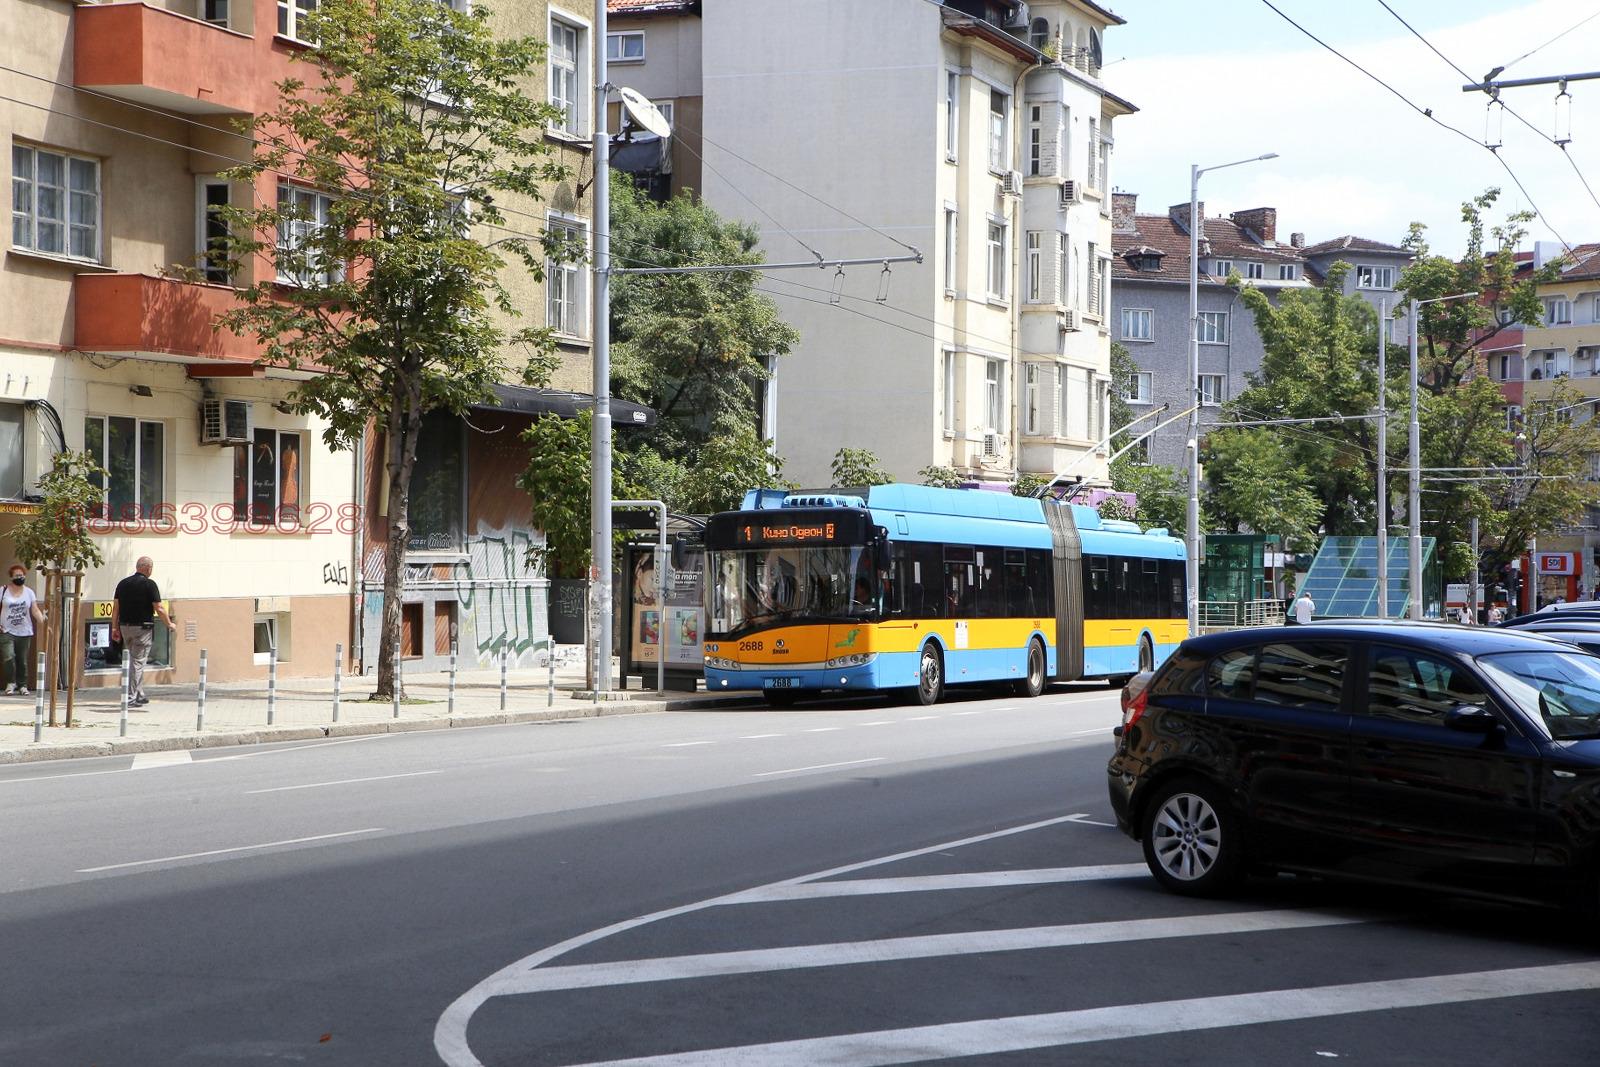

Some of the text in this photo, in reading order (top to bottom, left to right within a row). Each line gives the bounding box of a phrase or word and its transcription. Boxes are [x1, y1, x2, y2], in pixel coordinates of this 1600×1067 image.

[744, 526, 823, 541] 1 Кино Одеон
[717, 620, 722, 633] 1
[740, 641, 764, 652] 2688
[772, 679, 792, 688] 2688
